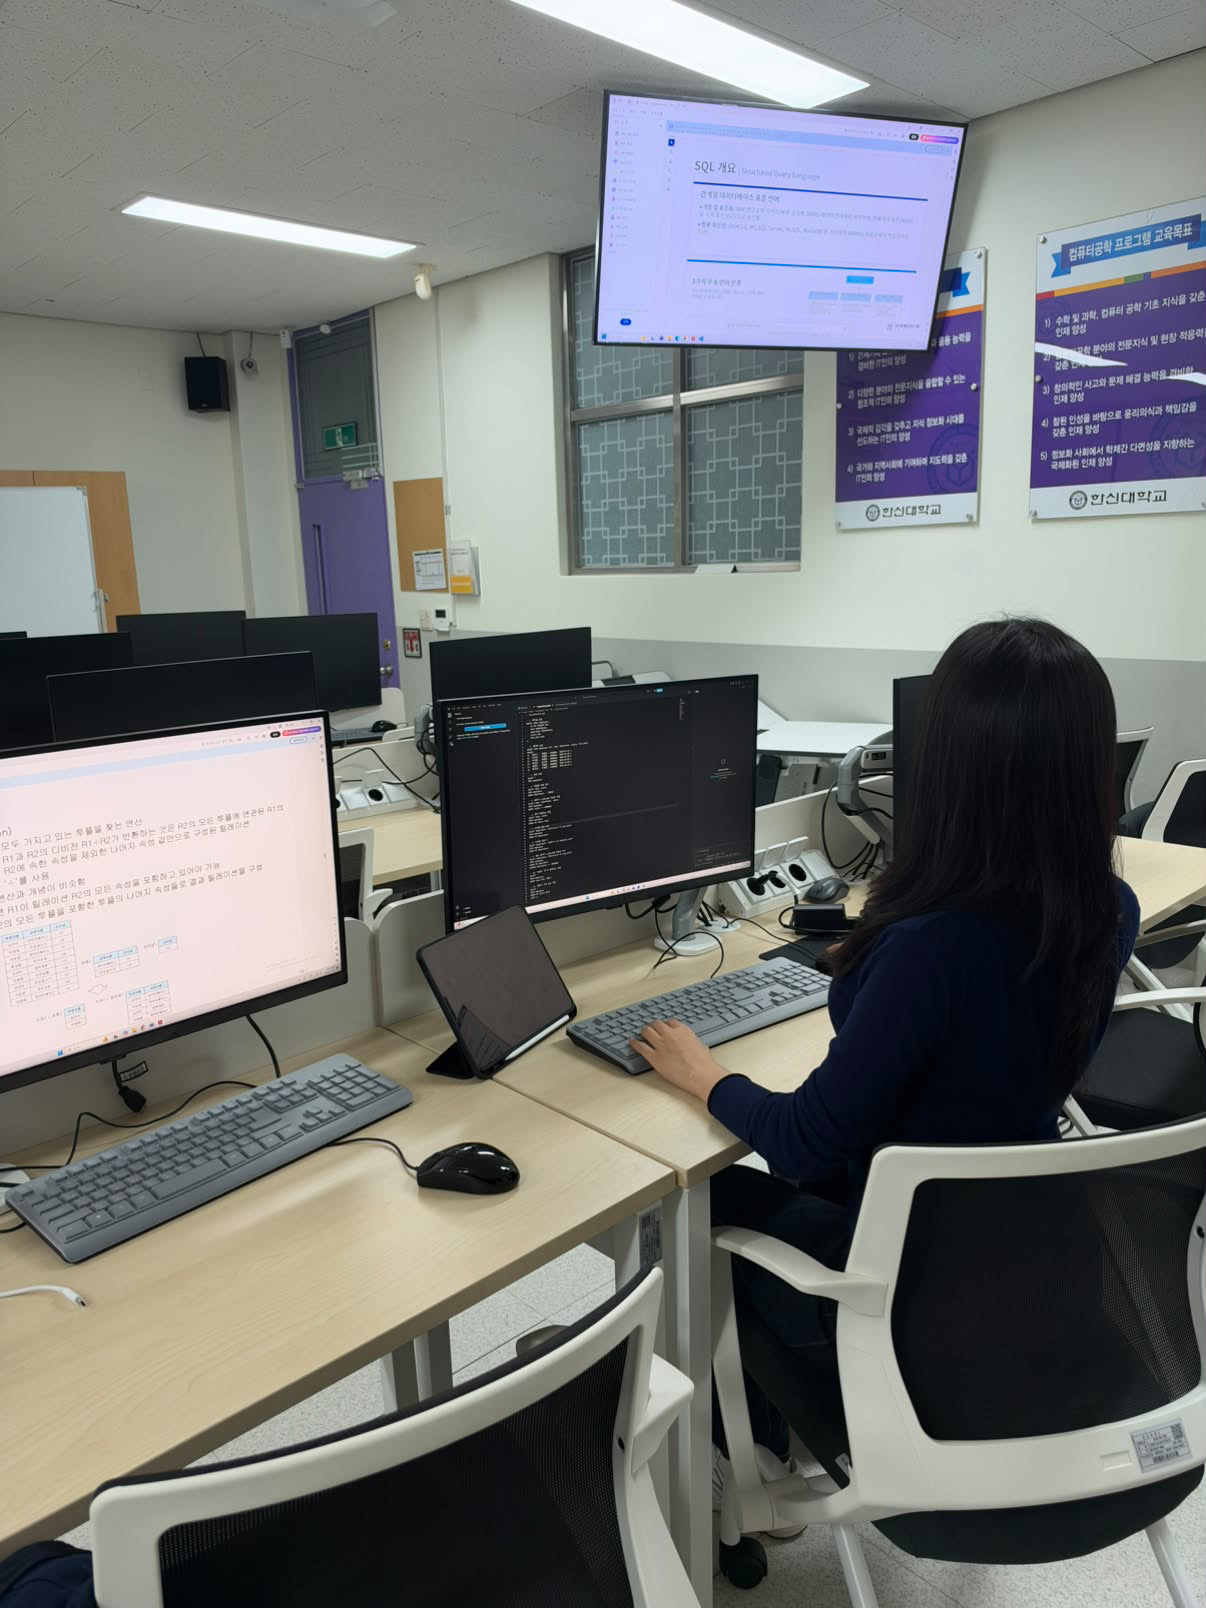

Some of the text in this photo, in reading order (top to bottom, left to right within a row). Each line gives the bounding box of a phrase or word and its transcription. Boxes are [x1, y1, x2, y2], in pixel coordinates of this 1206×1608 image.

[695, 160, 736, 173] SQL 개요
[1069, 222, 1193, 262] 컴퓨터공학 프로그램 교육목표
[1045, 318, 1051, 329] 1)
[1056, 314, 1071, 326] 수학
[1072, 313, 1080, 323] 및
[1101, 305, 1124, 319] 컴퓨터
[1126, 302, 1142, 315] 공학
[1143, 299, 1160, 311] 기초
[1161, 294, 1187, 308] 지식을
[1056, 324, 1087, 338] 인재 양성
[1093, 341, 1116, 354] 분야의
[1117, 336, 1148, 351] 전문지식
[1151, 335, 1158, 346] 및
[1161, 332, 1177, 344] 현장
[1179, 328, 1206, 341] 적응력
[945, 375, 952, 385] 수
[953, 374, 966, 384] 있는
[1042, 384, 1050, 395] 3)
[1053, 381, 1083, 394] 창의적인
[1084, 377, 1107, 389] 사고와
[1108, 375, 1124, 387] 문제
[1125, 372, 1141, 384] 해결
[1143, 369, 1167, 383] 능력을
[1053, 392, 1085, 405] 인재 양성
[1041, 401, 1197, 428] 4) 참된 인성을 바탕으로 윤리의식과 책임감을
[912, 418, 925, 429] 지식
[1052, 424, 1100, 438] 갖춘 인재 양성
[1040, 451, 1048, 461] 5)
[1052, 449, 1073, 460] 정보화
[1074, 446, 1103, 458] 사회에서
[1163, 437, 1195, 449] 지향하는
[955, 452, 968, 463] 갖춘
[1051, 456, 1113, 471] 국제화된 인재 양성
[1091, 490, 1167, 506] 한신대학교
[882, 504, 941, 518] 한신대학교
[1, 840, 20, 851] 모두
[24, 834, 51, 847] 가지고
[55, 831, 72, 841] 있는
[106, 821, 122, 831] 찾는
[125, 818, 142, 828] 연산
[2, 853, 24, 864] R1과
[27, 848, 48, 860] R2의
[52, 842, 78, 855] 디비전
[122, 828, 157, 841] 반환하는
[160, 823, 175, 834] 것은
[177, 820, 196, 831] R2의
[199, 817, 214, 826] 모든
[266, 804, 284, 814] R1의
[4, 864, 25, 875] R2에
[29, 859, 47, 869] 속한
[51, 853, 77, 865] 속성을
[81, 847, 107, 860] 제외한
[110, 842, 136, 854] 나머지
[139, 839, 155, 847] 속성
[194, 826, 217, 837] 구성된
[32, 871, 49, 882] 사용
[7, 903, 29, 915] R1이
[32, 894, 69, 909] 릴레이션
[71, 888, 92, 900] R2의
[95, 885, 111, 895] 모든
[115, 878, 140, 890] 속성을
[143, 870, 176, 884] 포함하고
[178, 865, 203, 877] 있어야
[28, 883, 56, 896] 개념이
[16, 914, 35, 925] 모든
[69, 901, 94, 913] 포함한
[126, 888, 151, 901] 나머지
